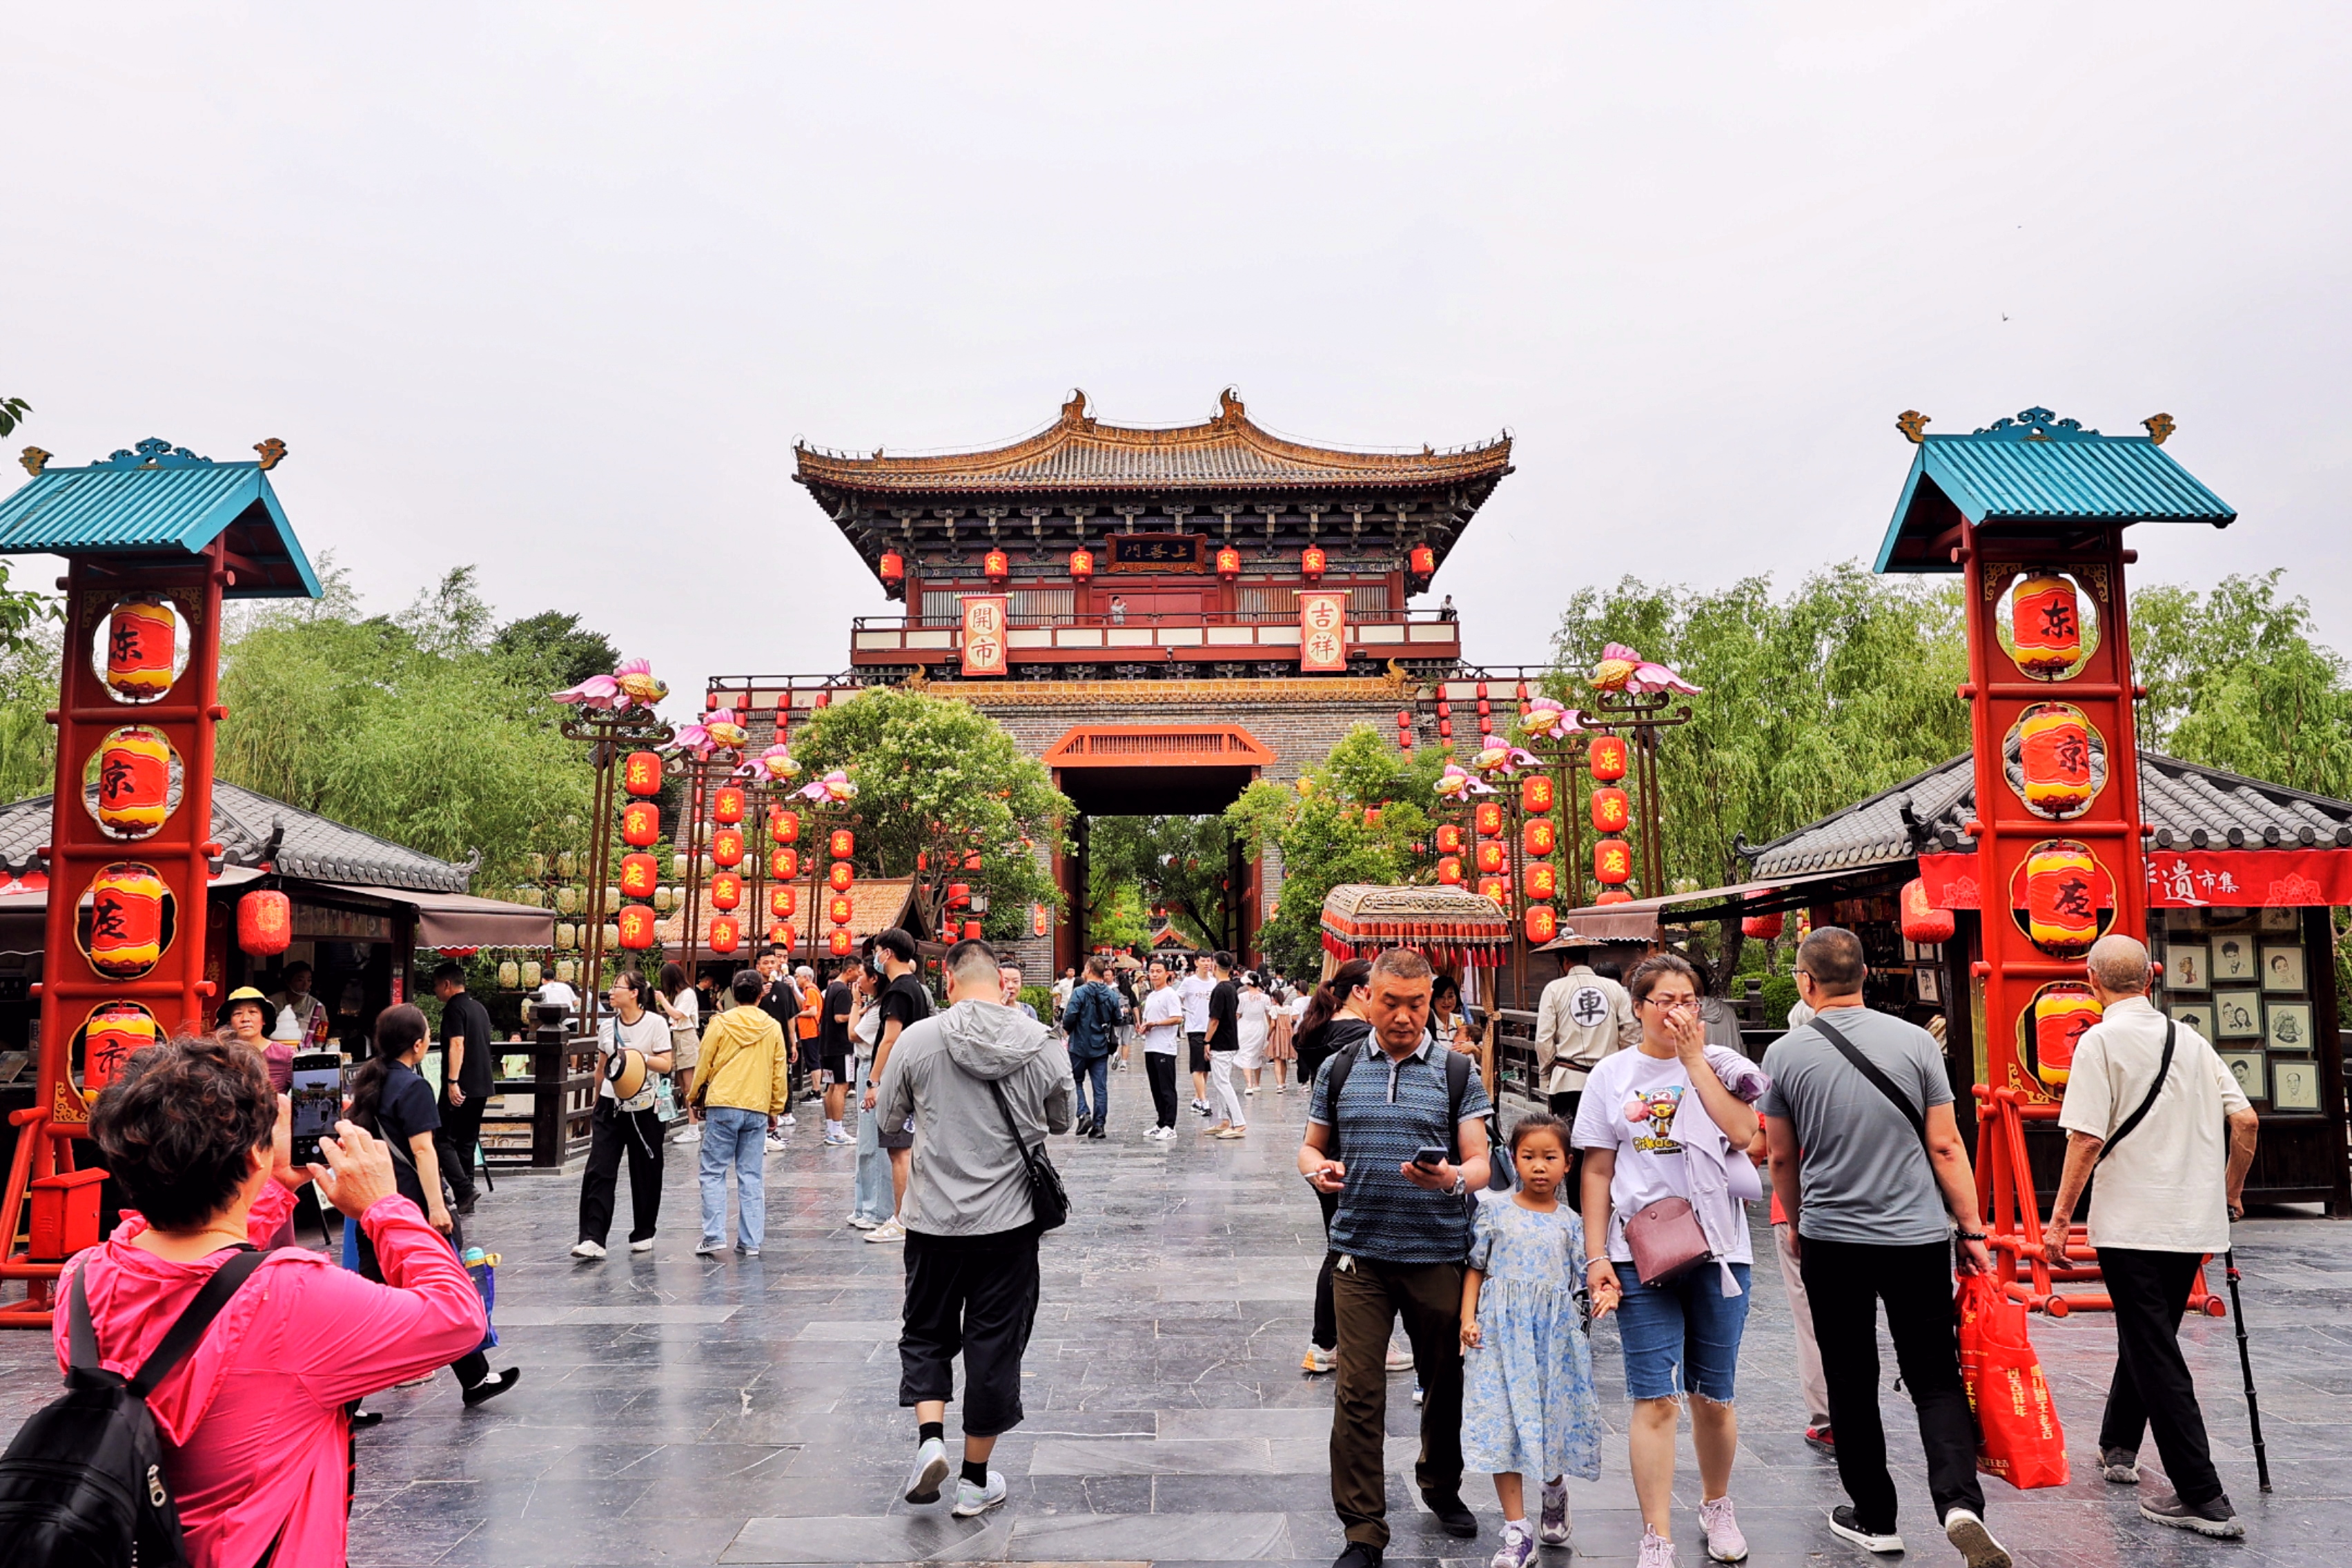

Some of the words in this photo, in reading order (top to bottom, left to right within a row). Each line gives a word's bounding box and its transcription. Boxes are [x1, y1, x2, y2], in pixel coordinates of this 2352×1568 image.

[988, 555, 1002, 572] 宋
[1073, 554, 1088, 571] 宋
[1219, 553, 1234, 569] 宋
[1306, 553, 1320, 569] 宋
[2041, 599, 2075, 639] 东
[970, 606, 997, 666] 開市
[1311, 601, 1335, 660] 吉祥
[111, 624, 143, 662] 东
[1599, 746, 1620, 772] 东
[2054, 734, 2088, 774] 京
[104, 761, 135, 801] 京
[629, 764, 649, 785] 东
[1532, 782, 1549, 802] 东
[720, 796, 737, 816] 东
[1601, 798, 1623, 823] 京
[627, 810, 647, 834] 京
[776, 819, 792, 835] 东
[1484, 809, 1499, 827] 东
[835, 837, 848, 852] 东
[1447, 830, 1458, 846] 东
[1533, 825, 1551, 847] 京
[718, 837, 736, 857] 京
[1485, 846, 1500, 864] 京
[776, 856, 791, 872] 京
[1448, 863, 1460, 879] 京
[834, 868, 847, 883] 京
[622, 914, 643, 940] 市
[714, 923, 731, 945] 市
[1536, 914, 1553, 935] 市
[774, 928, 788, 943] 市
[834, 932, 847, 949] 市
[1574, 990, 1606, 1023] 車
